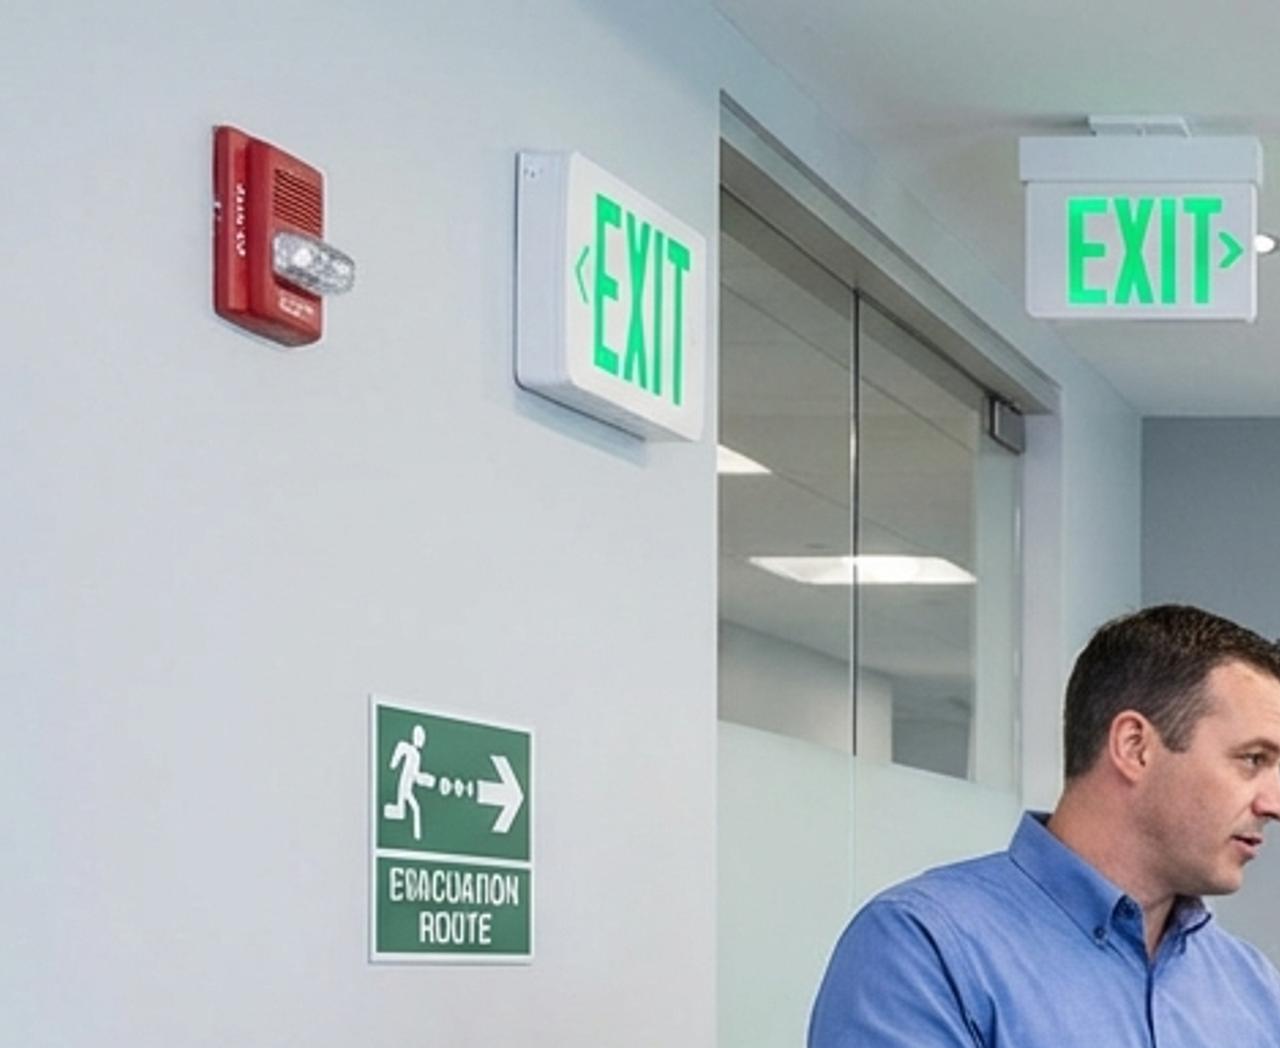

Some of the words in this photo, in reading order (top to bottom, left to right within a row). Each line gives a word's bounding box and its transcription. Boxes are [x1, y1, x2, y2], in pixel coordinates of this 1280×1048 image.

[593, 193, 690, 406] EXIT
[1067, 197, 1222, 304] EXIT
[419, 911, 492, 944] ROUTE
